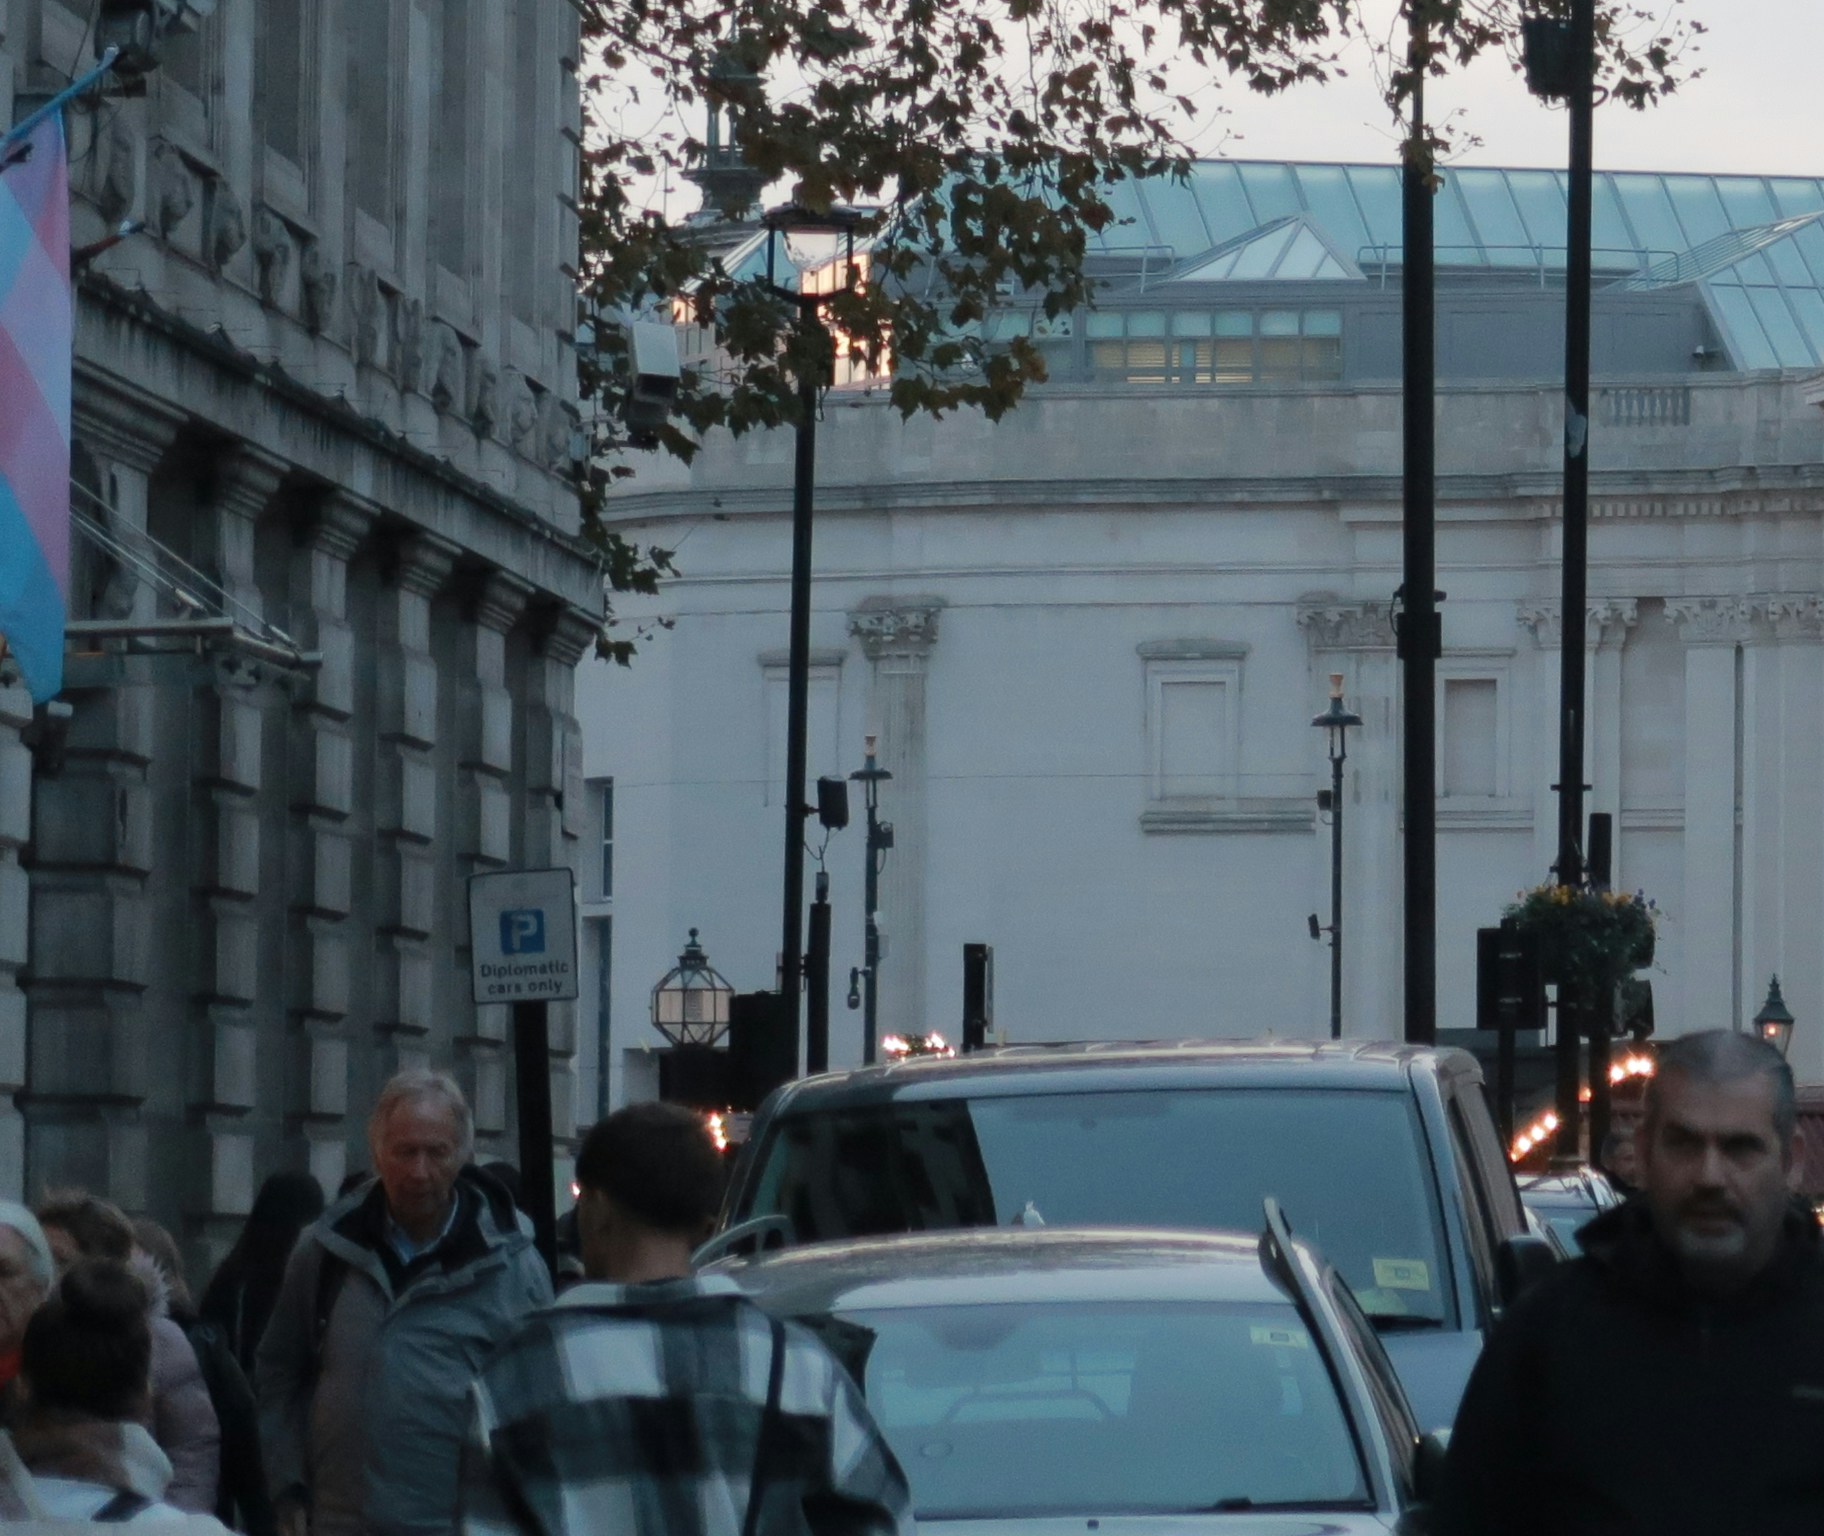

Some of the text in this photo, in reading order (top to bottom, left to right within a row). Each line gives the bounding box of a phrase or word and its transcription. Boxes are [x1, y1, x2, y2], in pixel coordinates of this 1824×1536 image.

[510, 913, 538, 950] P
[480, 960, 569, 978] Diplomatic
[488, 978, 563, 995] cars only
